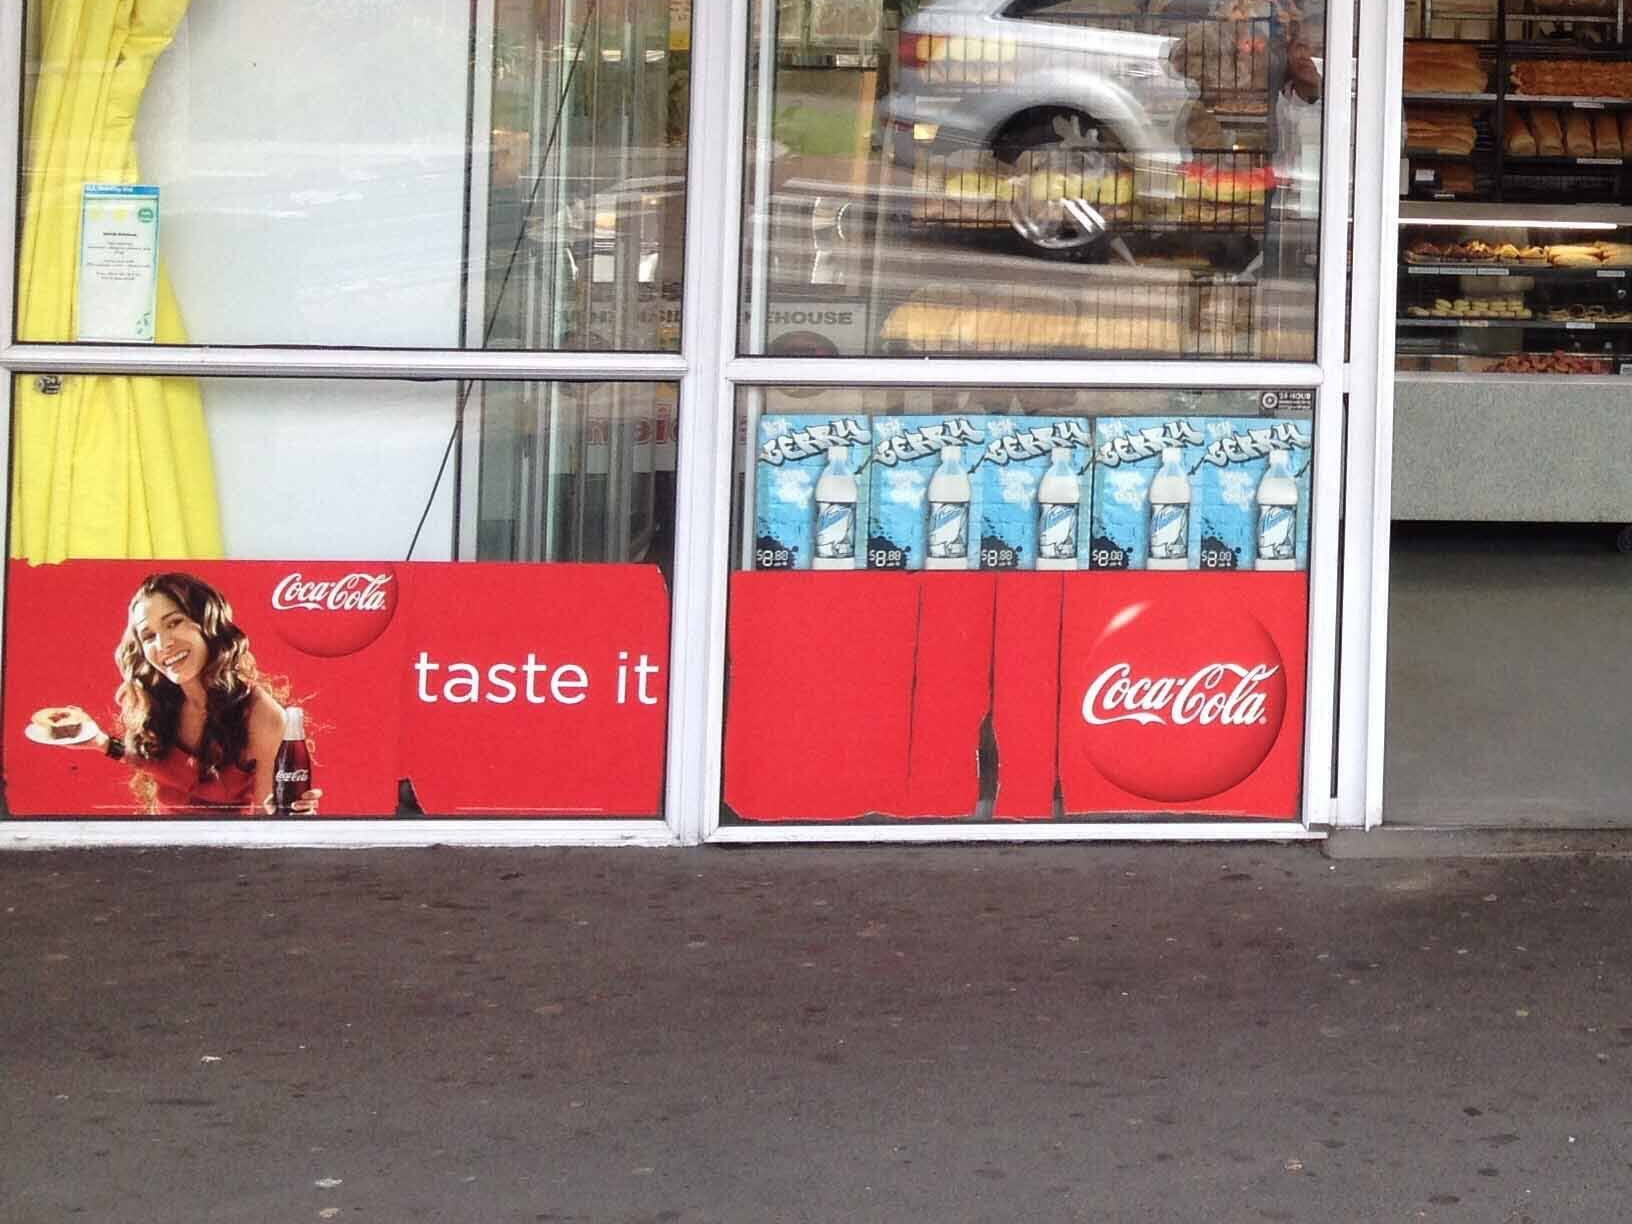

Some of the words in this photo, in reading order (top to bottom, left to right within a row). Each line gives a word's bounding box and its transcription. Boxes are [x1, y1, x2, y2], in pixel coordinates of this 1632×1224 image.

[272, 572, 393, 611] Coca-Cola
[414, 652, 589, 705] taste
[616, 651, 659, 705] it
[1081, 662, 1279, 726] Coca-Cola
